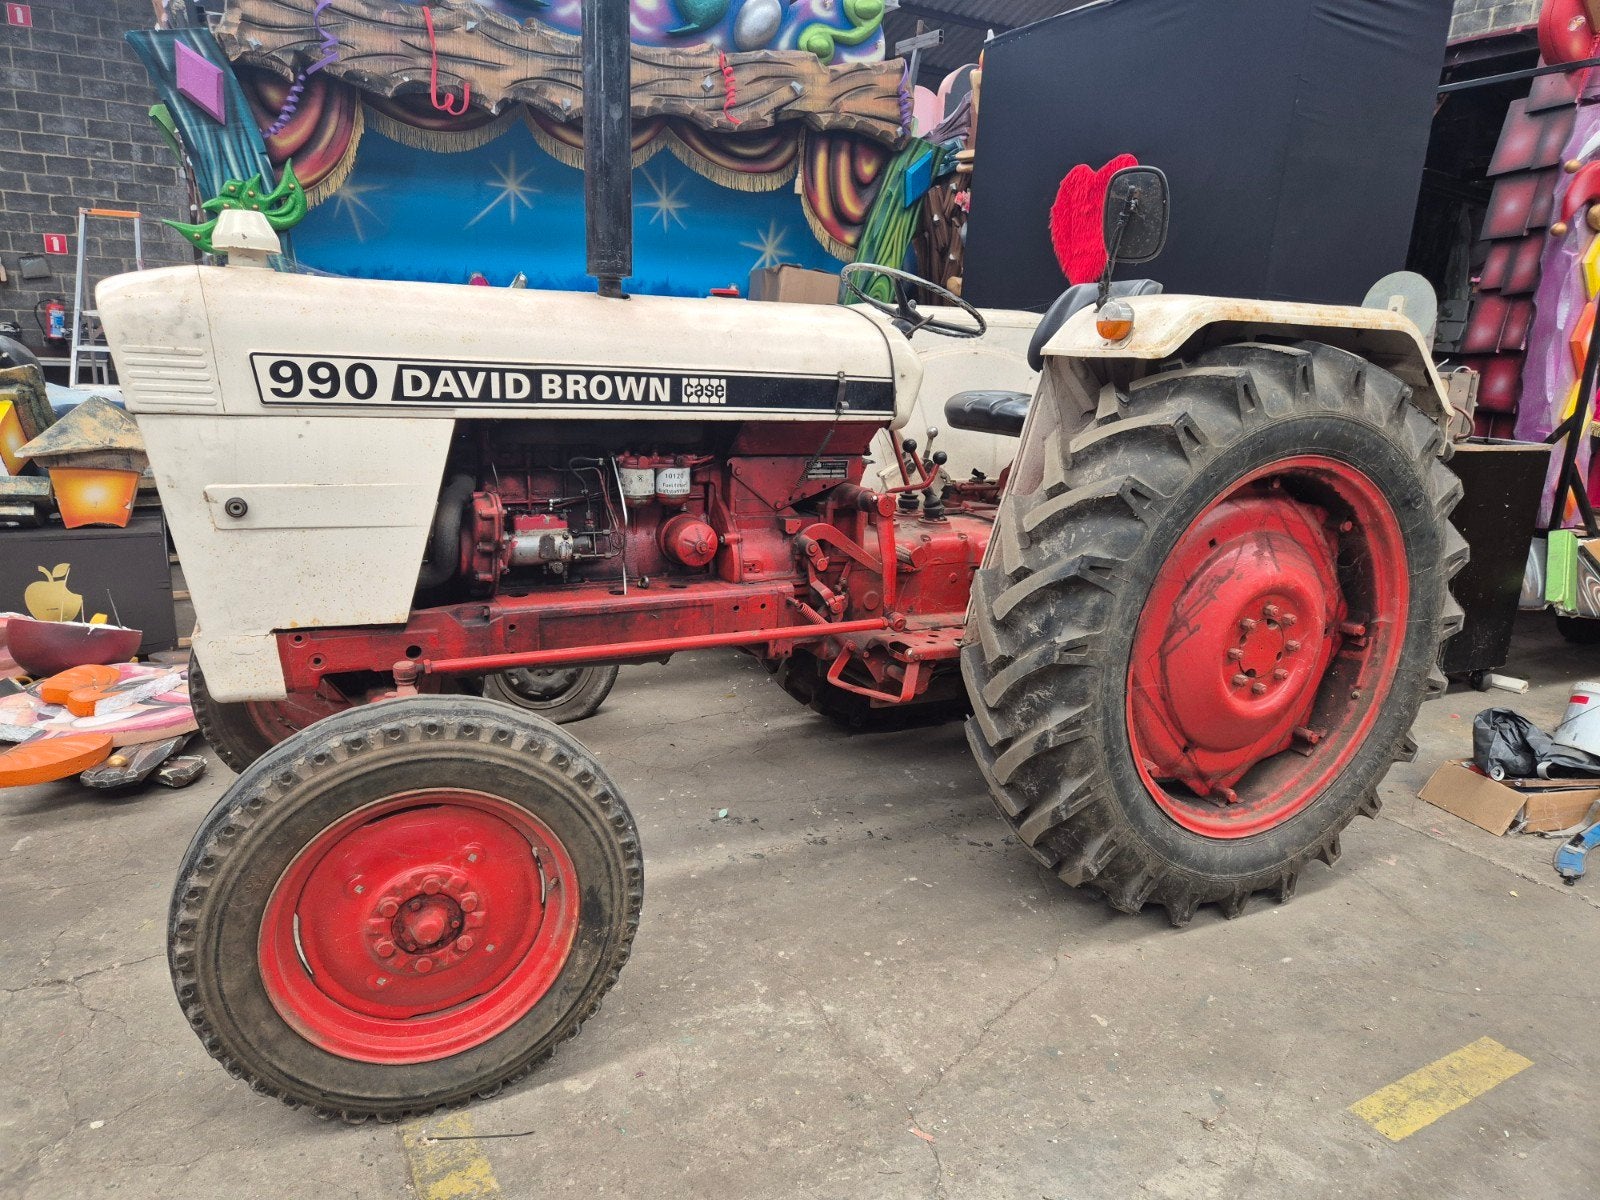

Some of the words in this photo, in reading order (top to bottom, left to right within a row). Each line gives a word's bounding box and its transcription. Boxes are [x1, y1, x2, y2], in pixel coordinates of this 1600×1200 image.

[269, 360, 378, 400] 990
[402, 369, 531, 399] DAVID
[541, 373, 671, 402] BROWN
[683, 380, 726, 402] case
